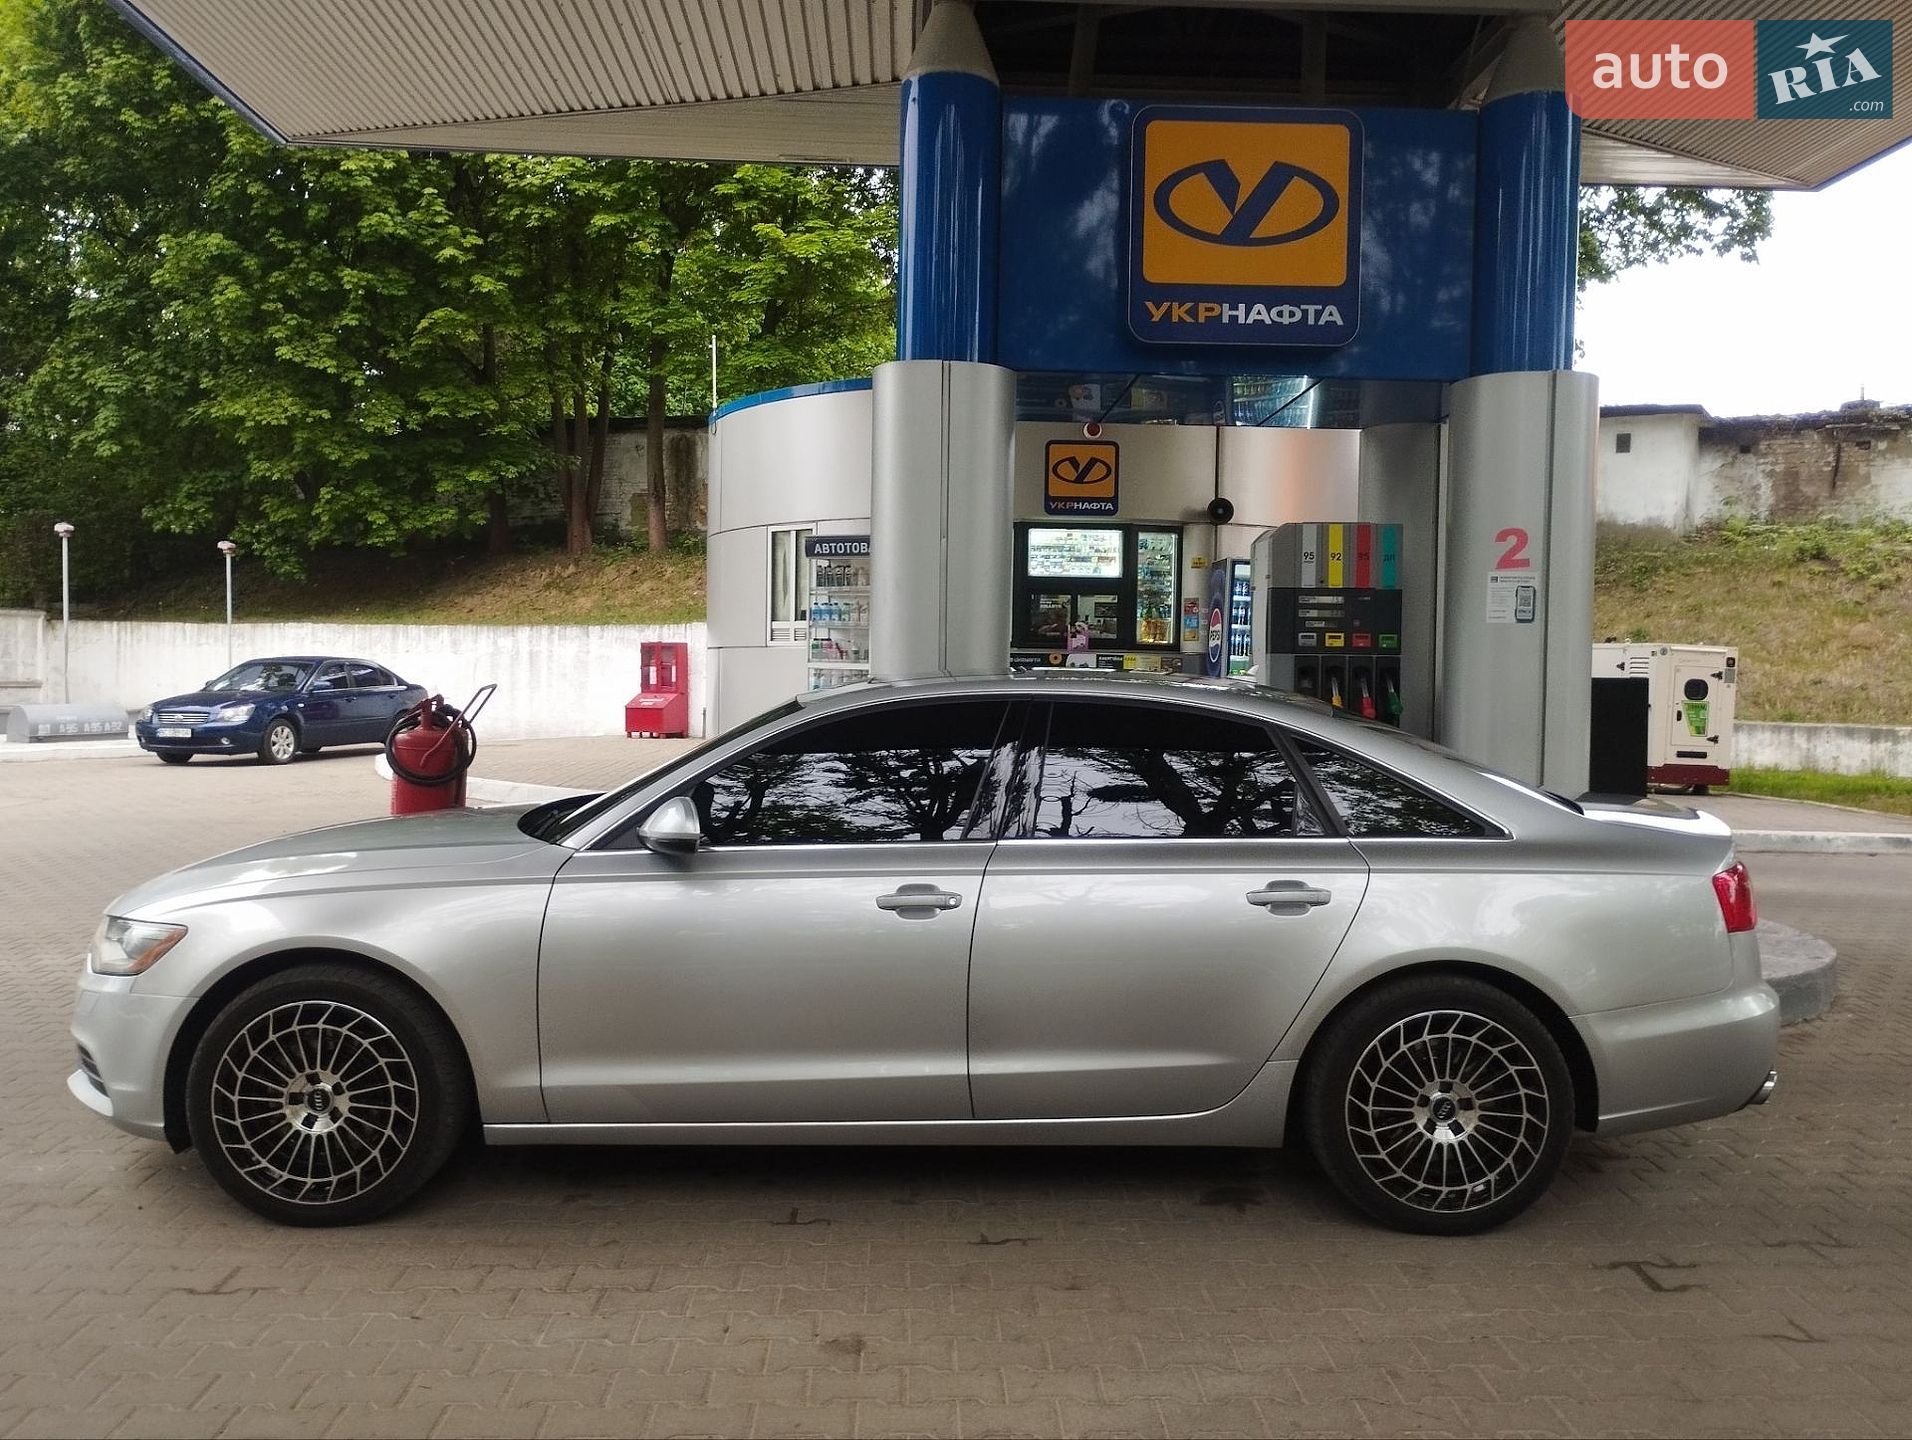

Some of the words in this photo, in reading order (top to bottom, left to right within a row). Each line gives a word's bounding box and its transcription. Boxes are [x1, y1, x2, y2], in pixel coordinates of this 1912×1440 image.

[1144, 301, 1345, 326] УКРНАФТА
[1050, 502, 1114, 510] УКРНАФТА
[814, 542, 870, 554] АВТОТОВ
[1494, 527, 1531, 570] 2
[1303, 551, 1315, 560] 95
[1330, 552, 1342, 561] 92
